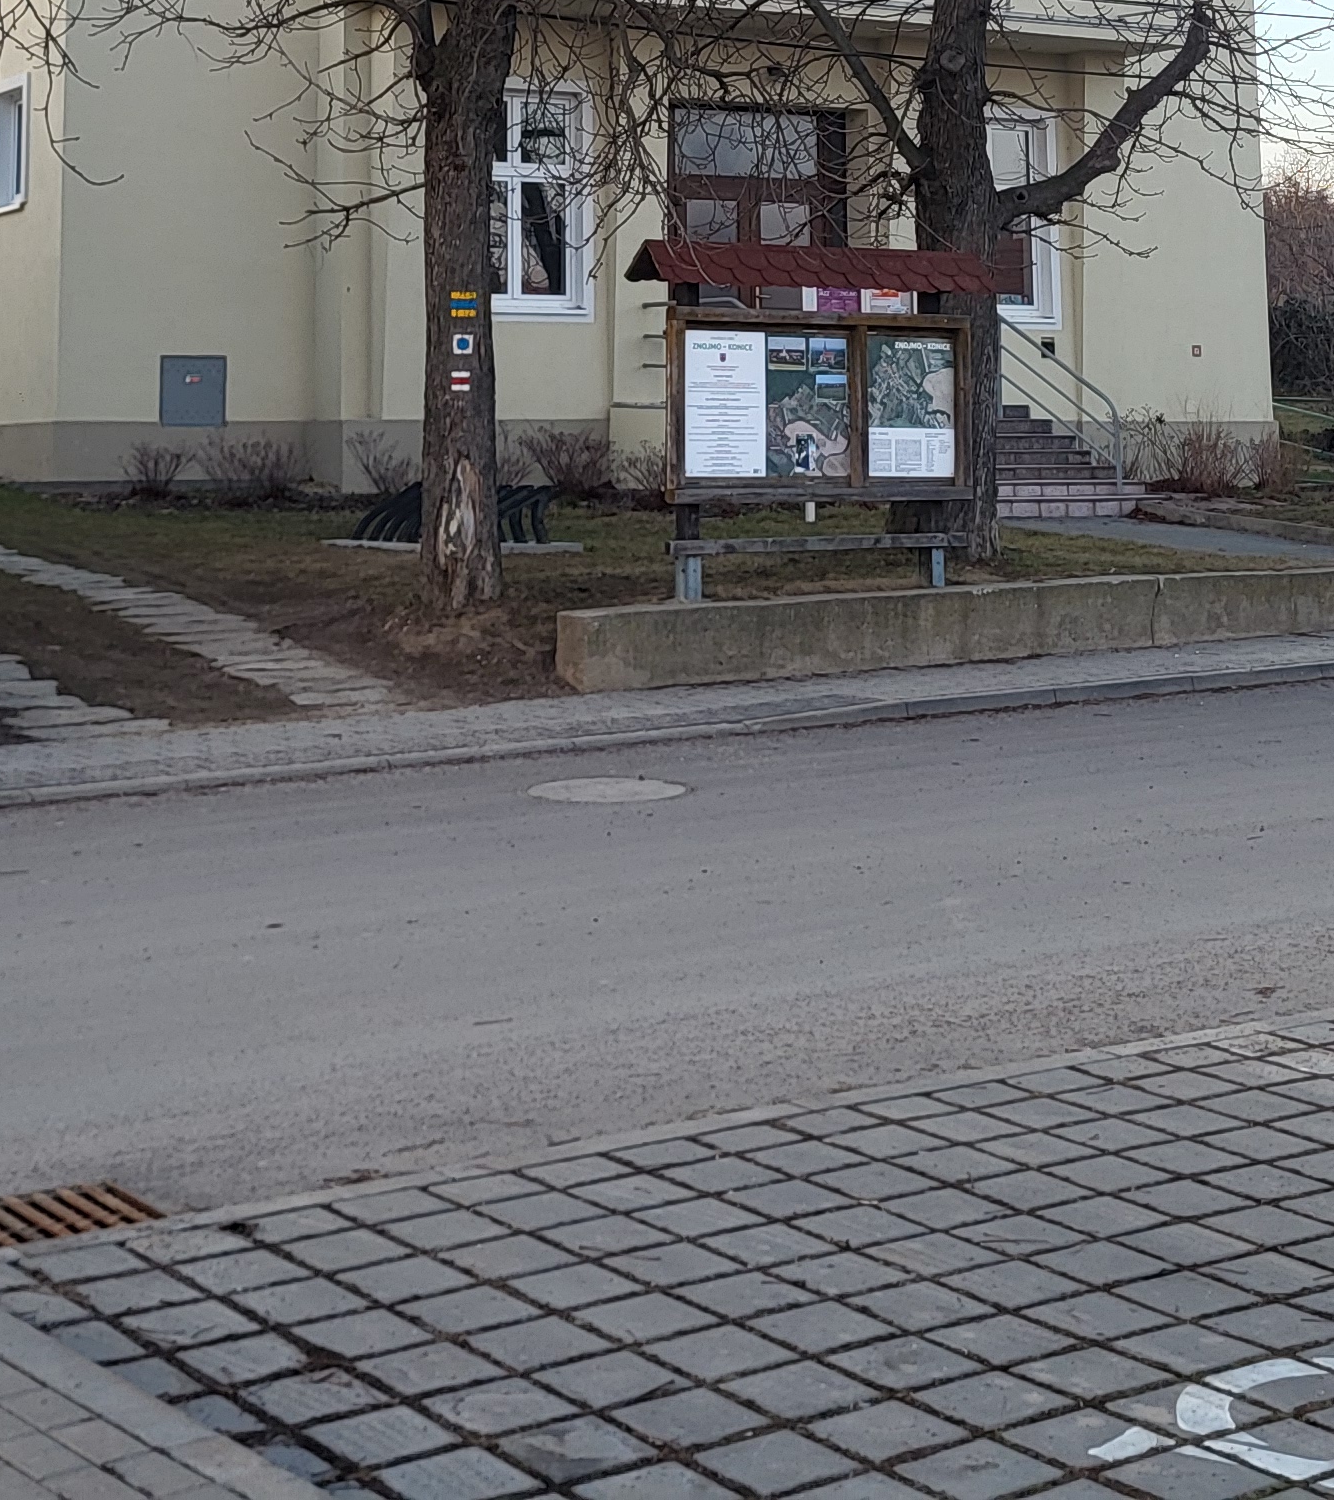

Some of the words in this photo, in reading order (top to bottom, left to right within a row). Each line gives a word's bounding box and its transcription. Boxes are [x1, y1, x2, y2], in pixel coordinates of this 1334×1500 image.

[692, 342, 722, 351] ZNOJMO
[727, 343, 753, 352] KONICE
[894, 341, 922, 350] ZNOJMO
[927, 342, 951, 351] KONICE
